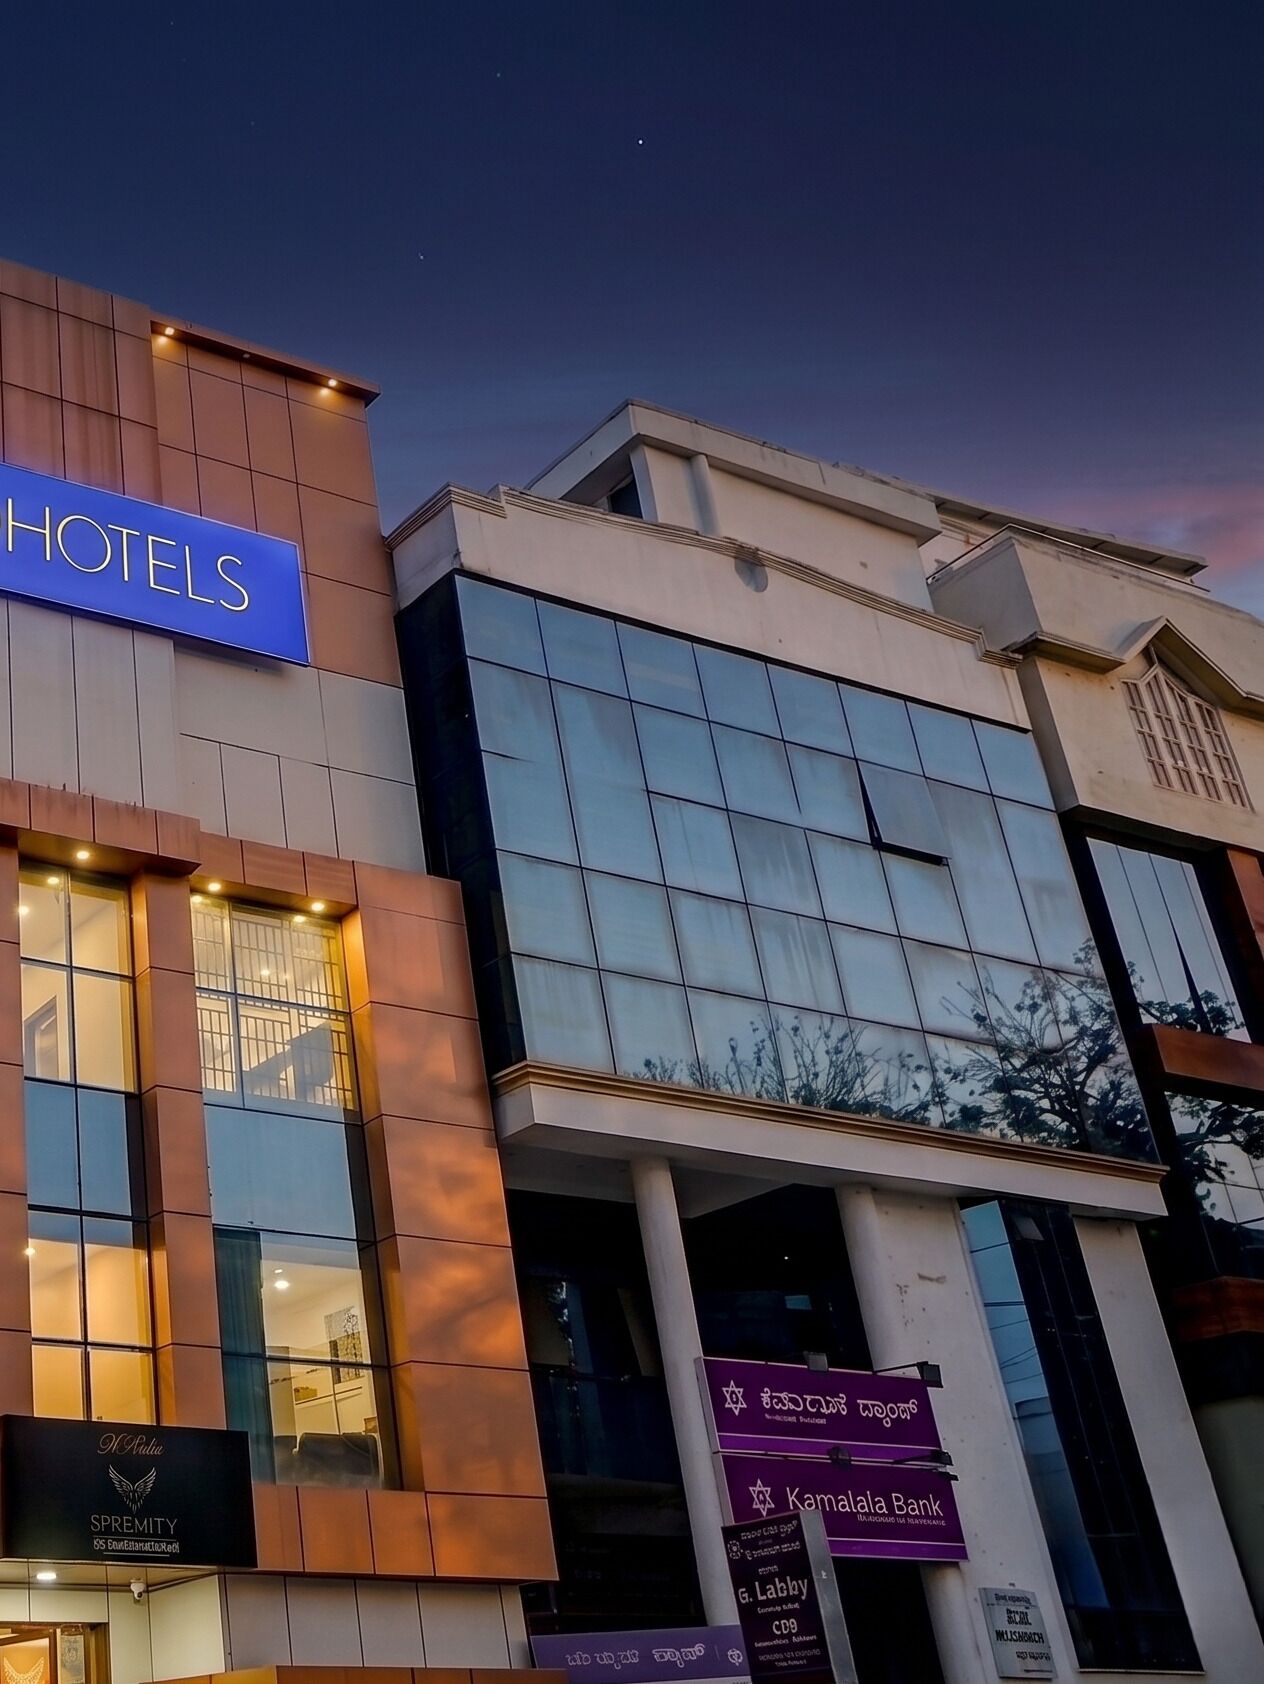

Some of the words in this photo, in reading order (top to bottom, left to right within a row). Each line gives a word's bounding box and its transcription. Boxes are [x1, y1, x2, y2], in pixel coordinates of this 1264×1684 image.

[786, 1486, 889, 1514] Kamalala
[891, 1492, 944, 1517] Bank
[90, 1514, 178, 1535] SPREMITY
